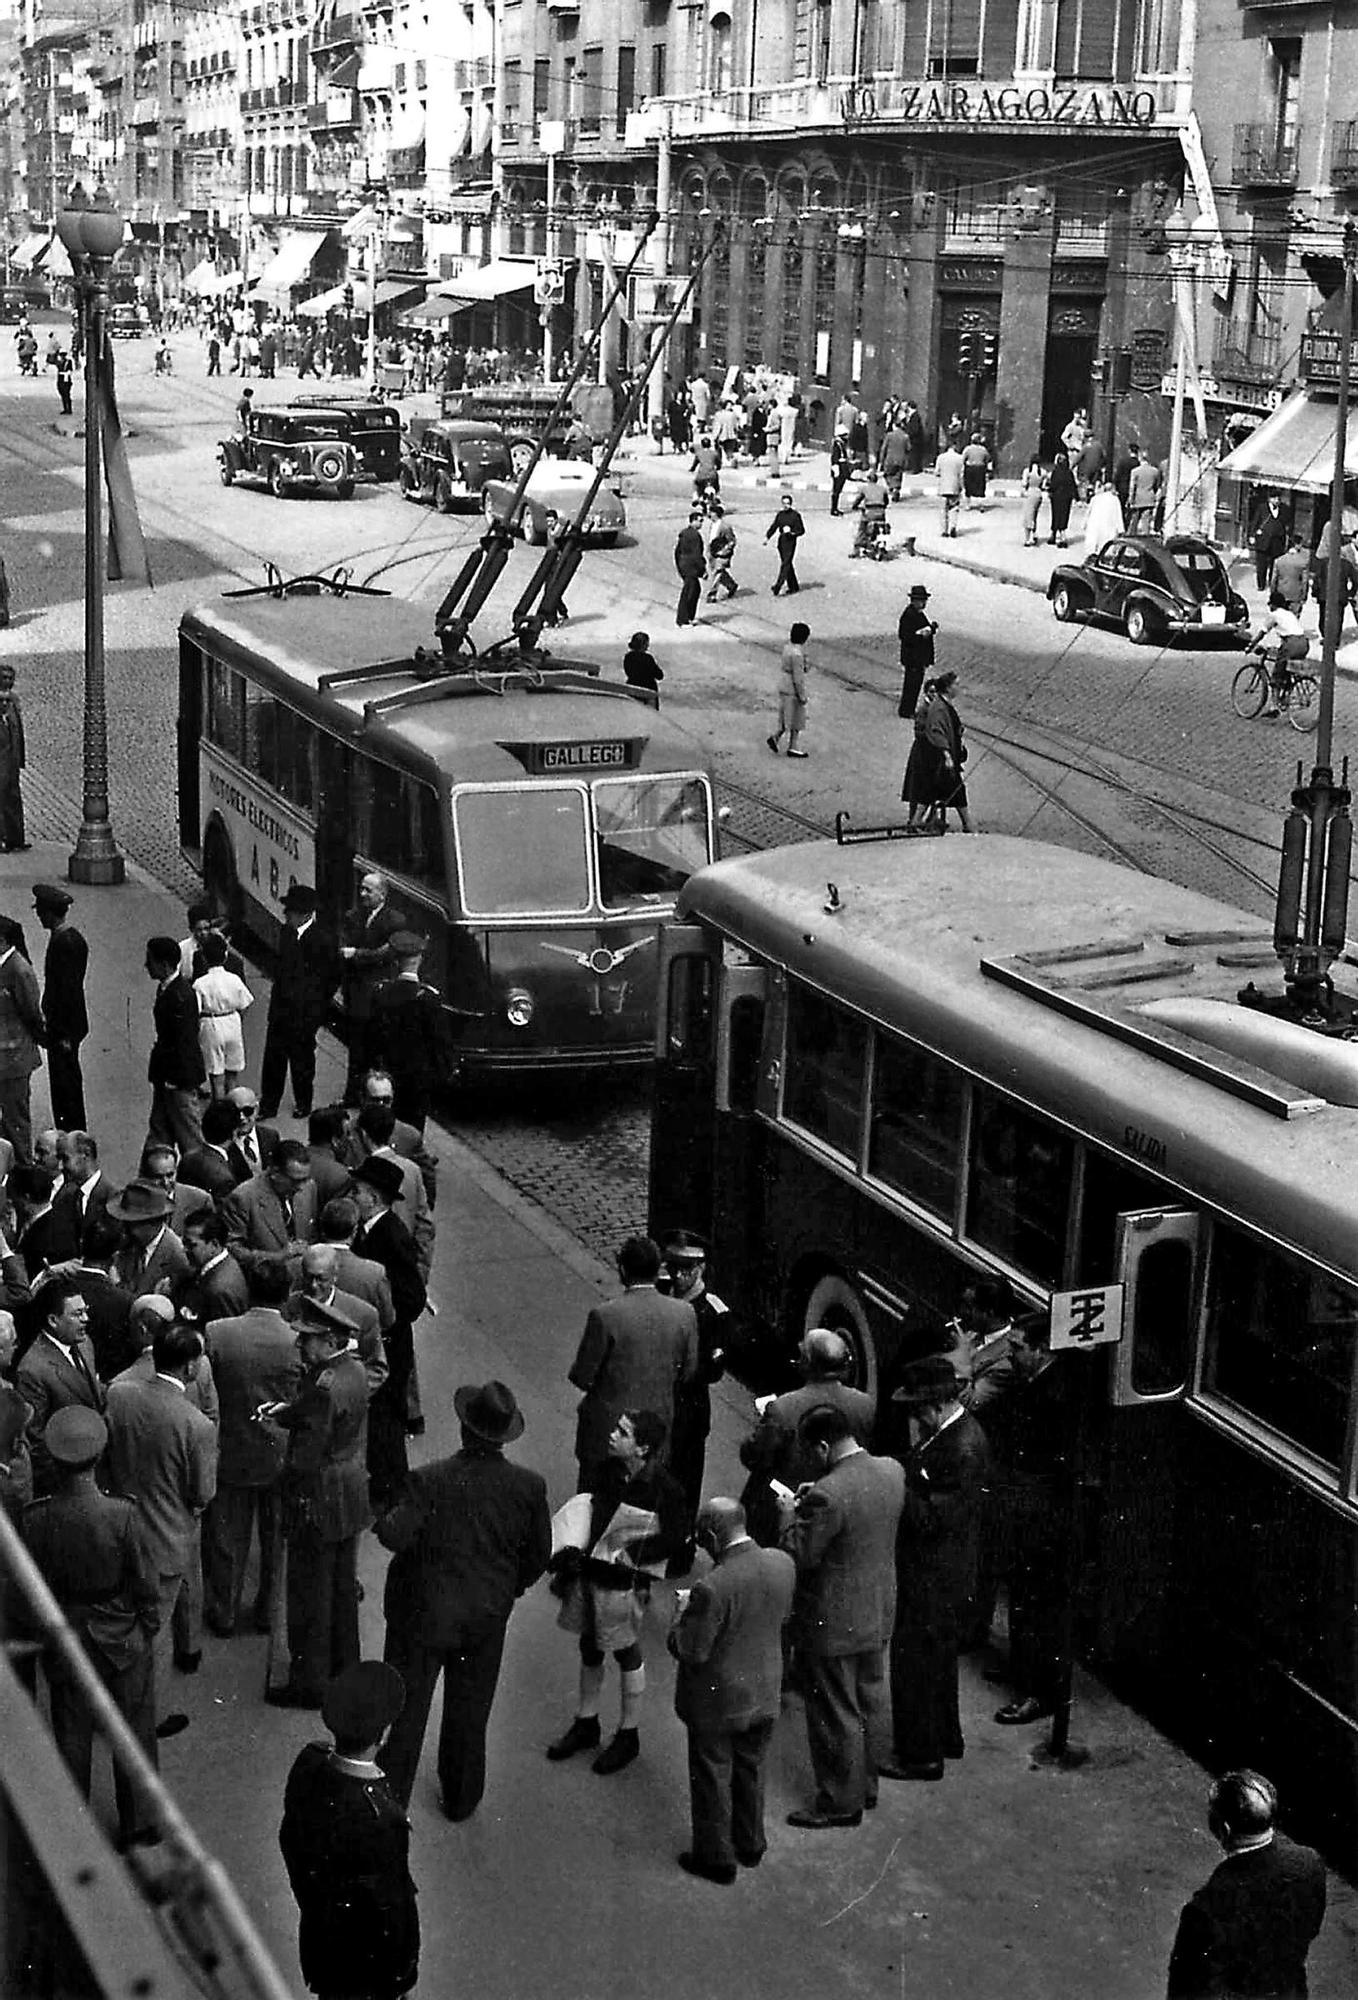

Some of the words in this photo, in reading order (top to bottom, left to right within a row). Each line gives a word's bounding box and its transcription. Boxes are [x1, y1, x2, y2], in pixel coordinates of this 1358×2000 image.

[901, 86, 1156, 126] ZARAGOZANO
[546, 745, 623, 768] GALLEGO
[249, 798, 299, 861] ELECTRICOS
